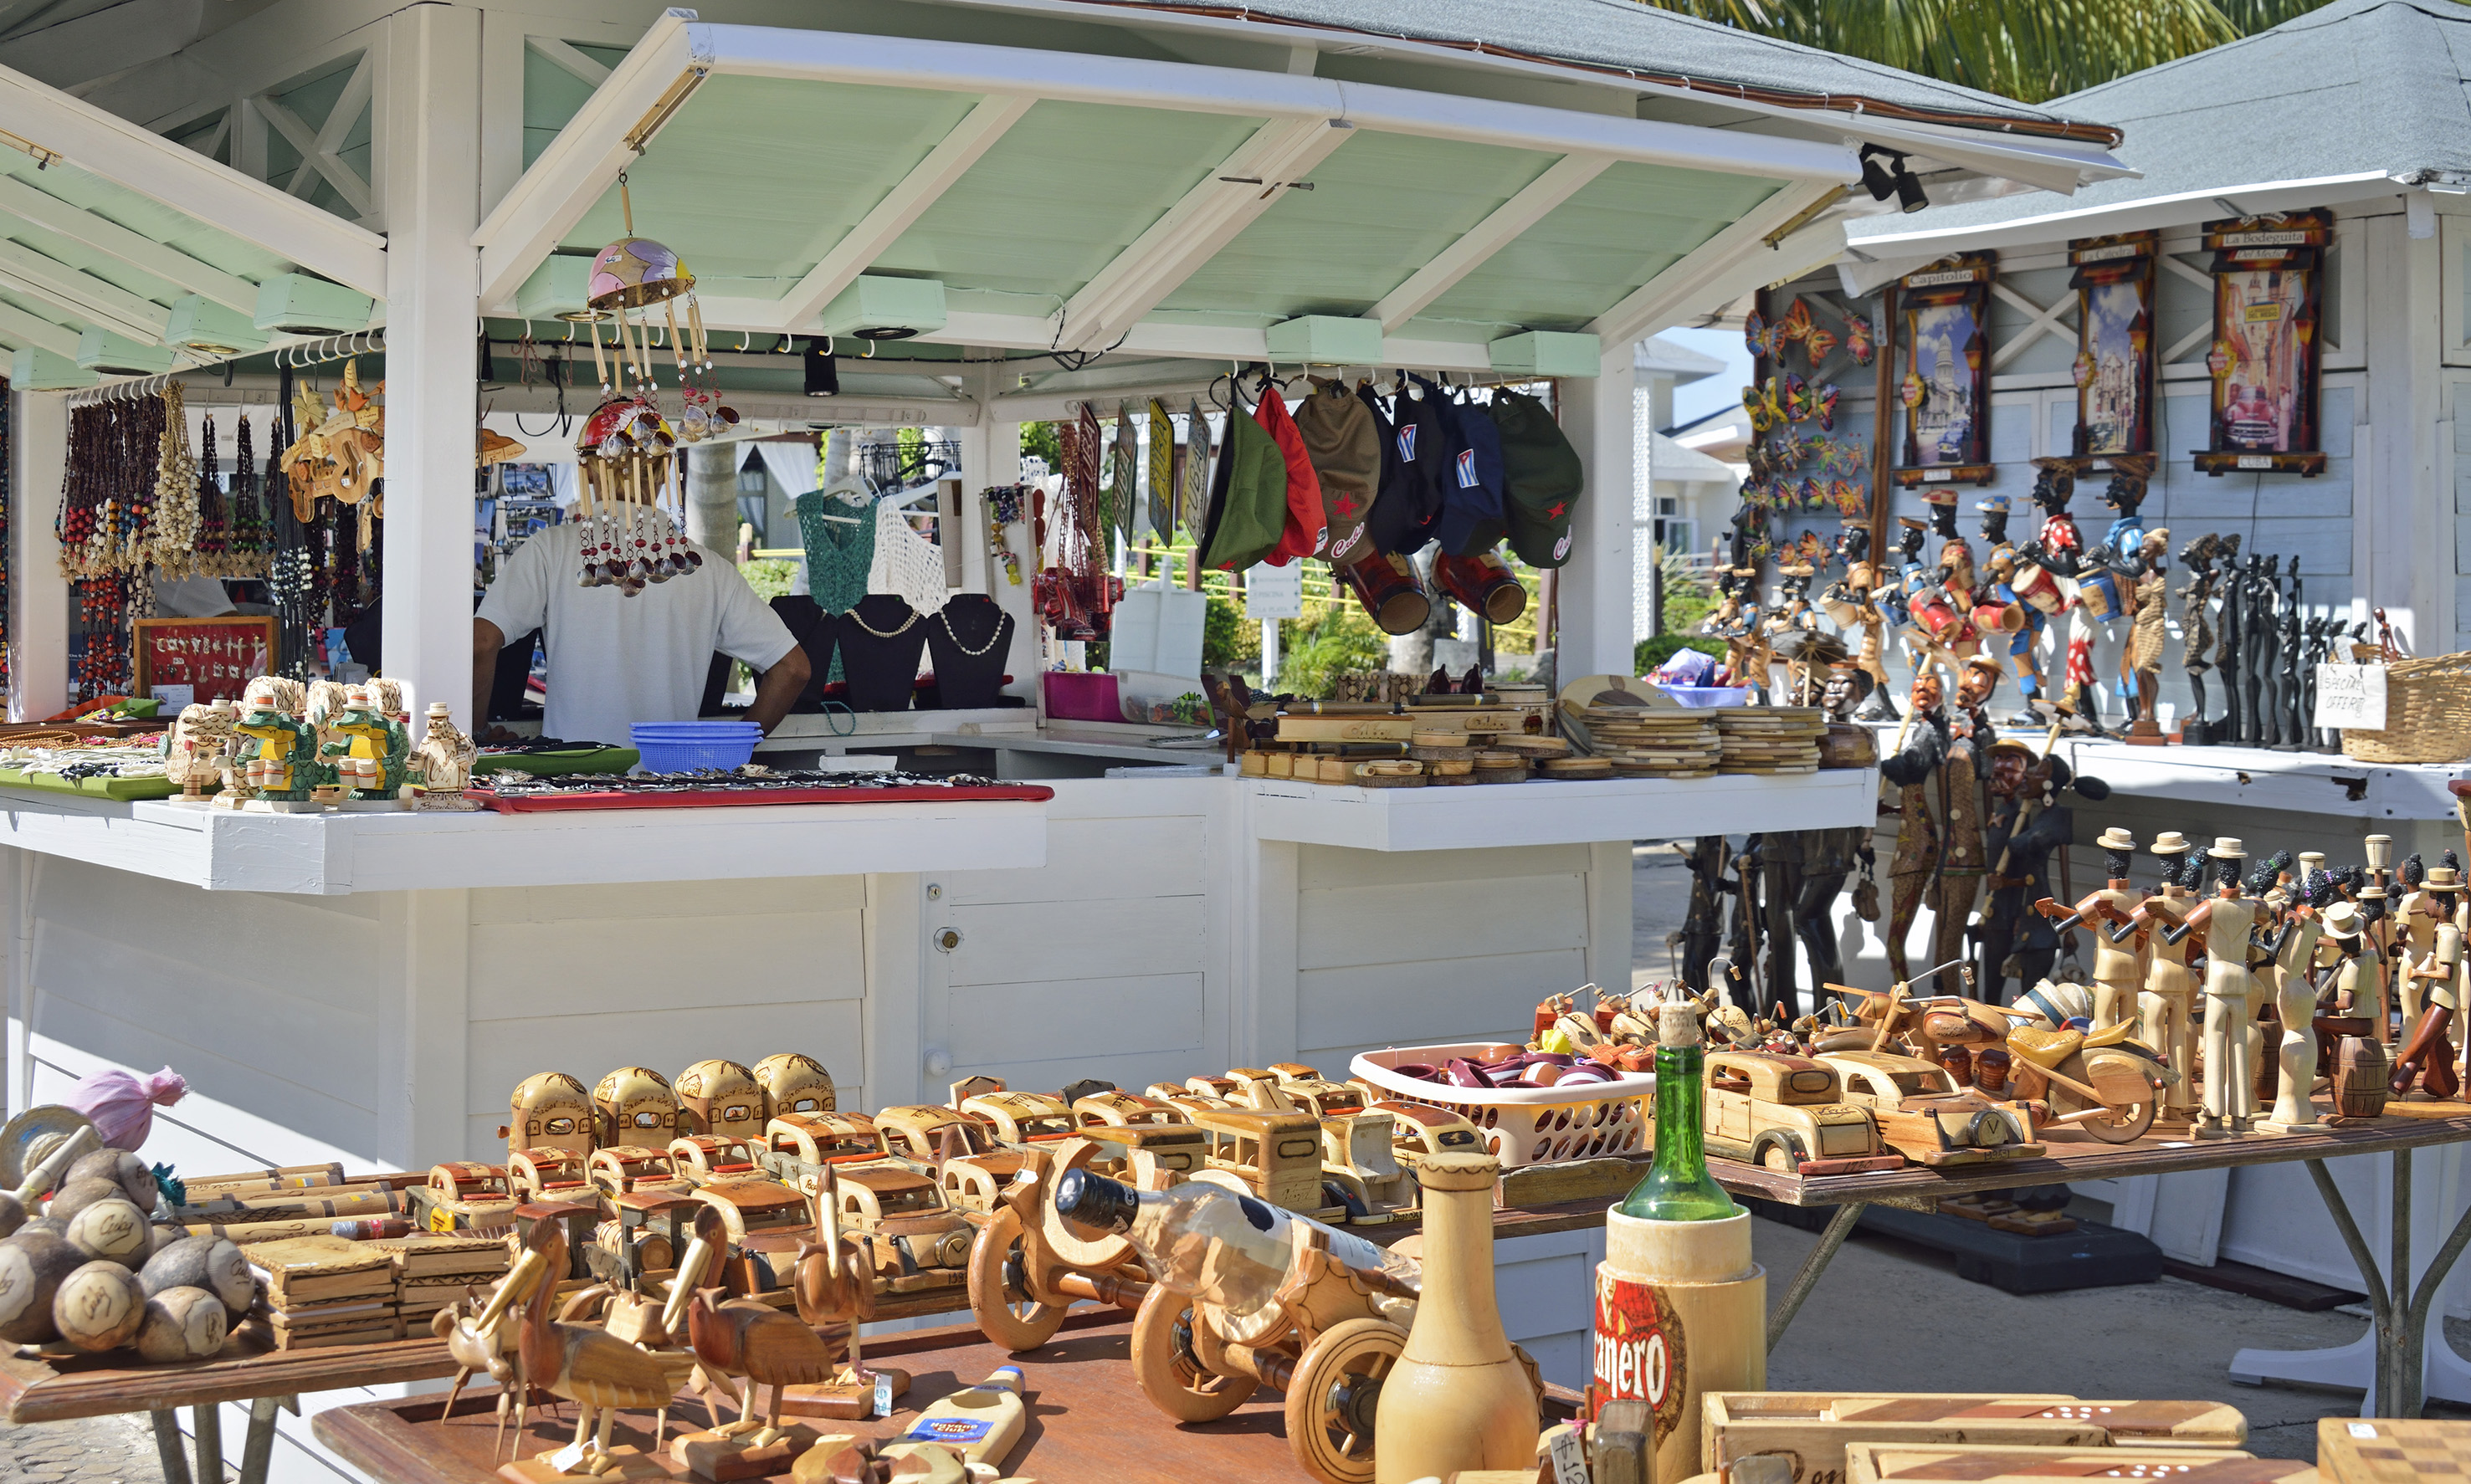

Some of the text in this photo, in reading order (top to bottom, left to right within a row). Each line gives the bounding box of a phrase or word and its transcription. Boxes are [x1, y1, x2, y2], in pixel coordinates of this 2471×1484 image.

[2226, 231, 2304, 245] La Bodeguita
[2081, 246, 2135, 262] La Catedral
[2237, 248, 2285, 258] Del Medio
[1909, 269, 1973, 286] Capitolio
[1082, 420, 1095, 503] CUBA
[1152, 418, 1167, 503] CUBA
[2240, 457, 2270, 468] CUBA
[1116, 447, 1130, 530] CUBA
[1186, 446, 1205, 529] CUBA
[1333, 523, 1364, 556] Cuba
[930, 1421, 979, 1430] Havana
